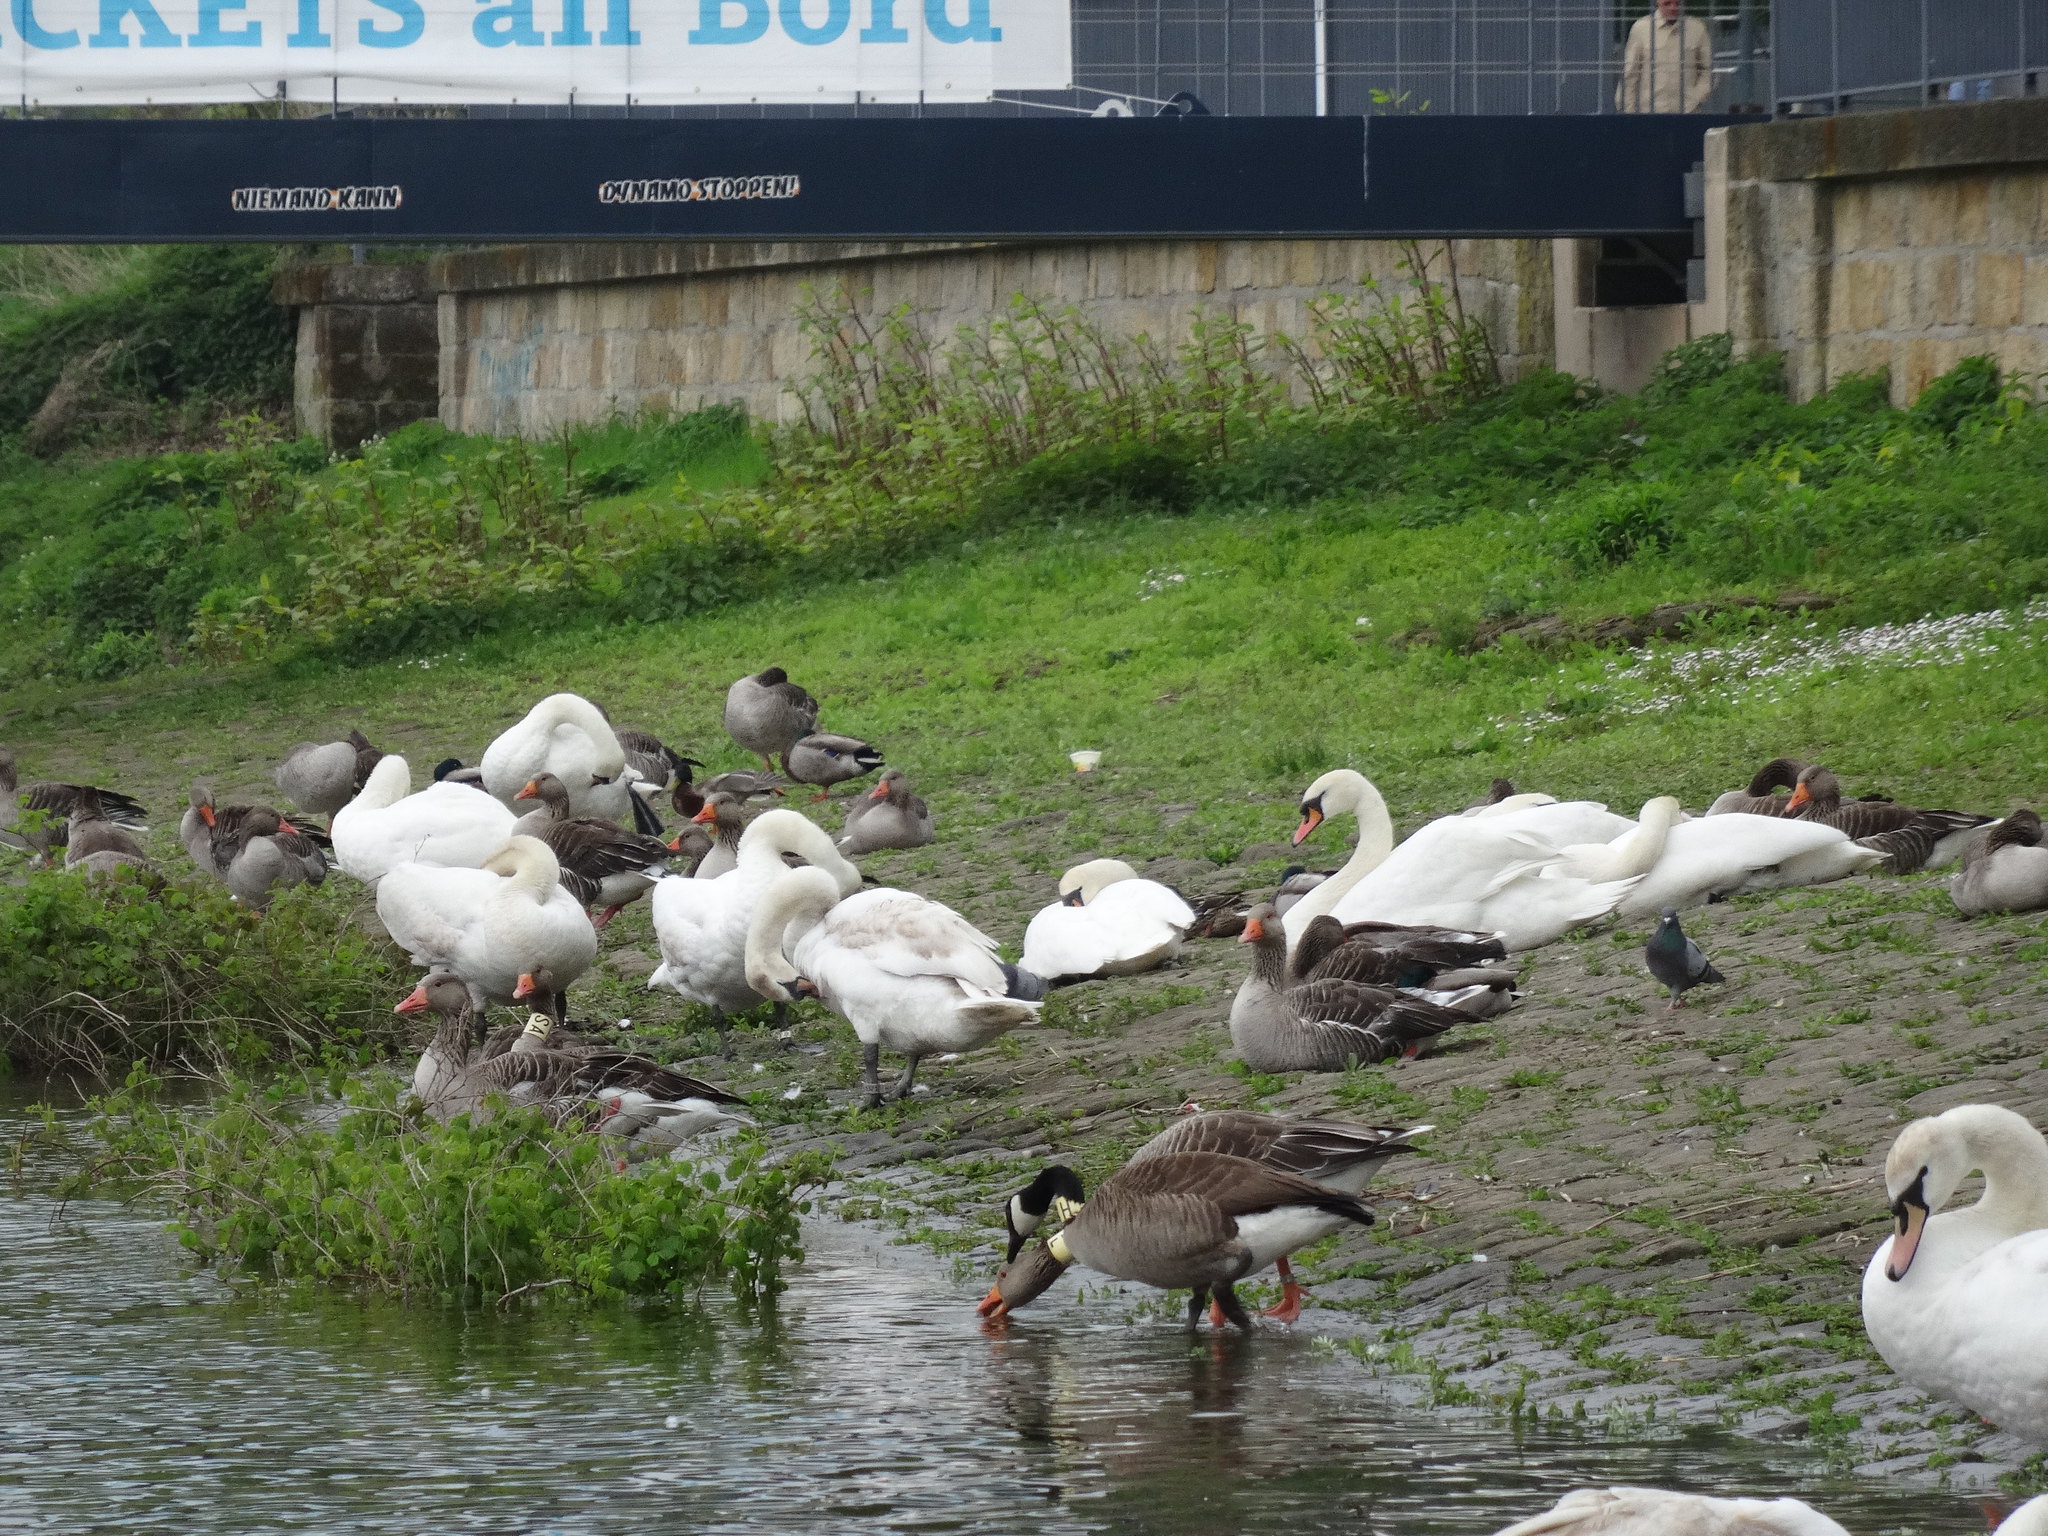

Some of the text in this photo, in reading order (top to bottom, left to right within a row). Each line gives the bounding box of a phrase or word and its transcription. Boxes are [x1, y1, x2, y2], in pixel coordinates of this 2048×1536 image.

[0, 0, 426, 49] CKETS
[688, 0, 1002, 45] Bord
[233, 184, 400, 211] NIEMAND KANN
[600, 174, 799, 203] DYNAMO STOPPEN!
